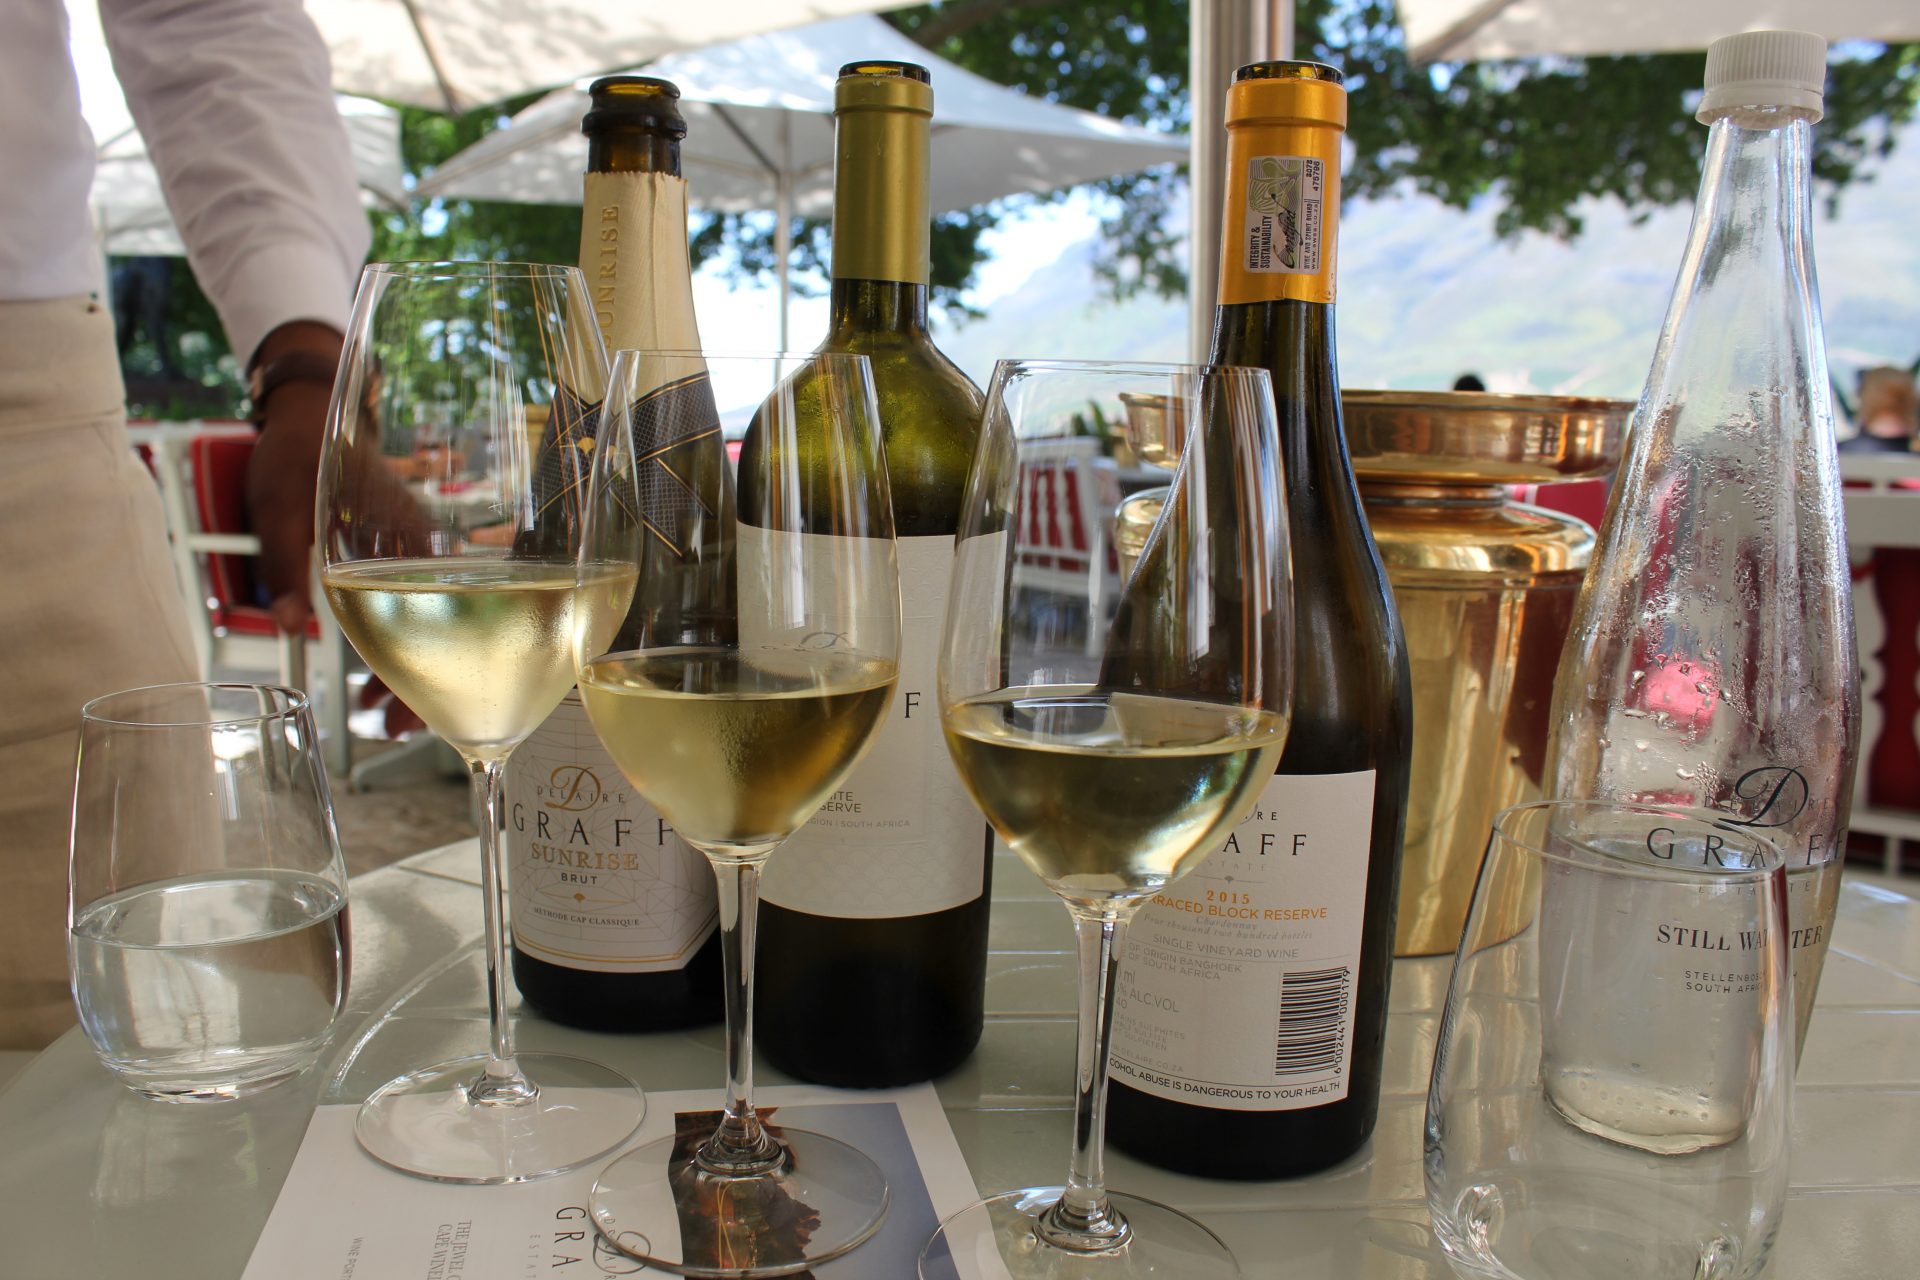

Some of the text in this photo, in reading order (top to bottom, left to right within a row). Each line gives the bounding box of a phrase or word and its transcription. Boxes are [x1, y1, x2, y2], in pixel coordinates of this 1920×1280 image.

[1250, 226, 1260, 269] INTEGRITY &
[1260, 215, 1272, 269] SUSTAINABILITY
[820, 801, 862, 813] SERVE
[830, 791, 854, 802] ITE
[531, 842, 640, 871] SUNRISE
[561, 872, 598, 885] BRUT
[1207, 890, 1250, 904] 2015
[570, 914, 587, 924] CAP
[589, 917, 640, 928] CLASSIQUE
[1208, 905, 1259, 920] BLOCK
[1264, 907, 1328, 921] RESERVE
[1153, 934, 1299, 958] SINGLE VINEYARD WINE
[1657, 924, 1731, 951] STILL
[1143, 948, 1177, 963] ORIGIN
[1180, 957, 1242, 973] BANGHOEK
[1179, 967, 1220, 980] AFRICA
[1686, 982, 1731, 993] SOUTH
[1139, 1071, 1170, 1088] ABUSE
[1172, 1080, 1182, 1090] IS
[1184, 1083, 1253, 1099] DANGEROUS
[1257, 1090, 1271, 1099] TO
[1274, 1088, 1303, 1099] YOUR
[1304, 1081, 1340, 1096] HEALTH
[434, 1224, 453, 1249] CAPE
[455, 1220, 472, 1241] THE
[349, 1236, 365, 1257] WINE
[448, 1241, 469, 1274] JEWEL
